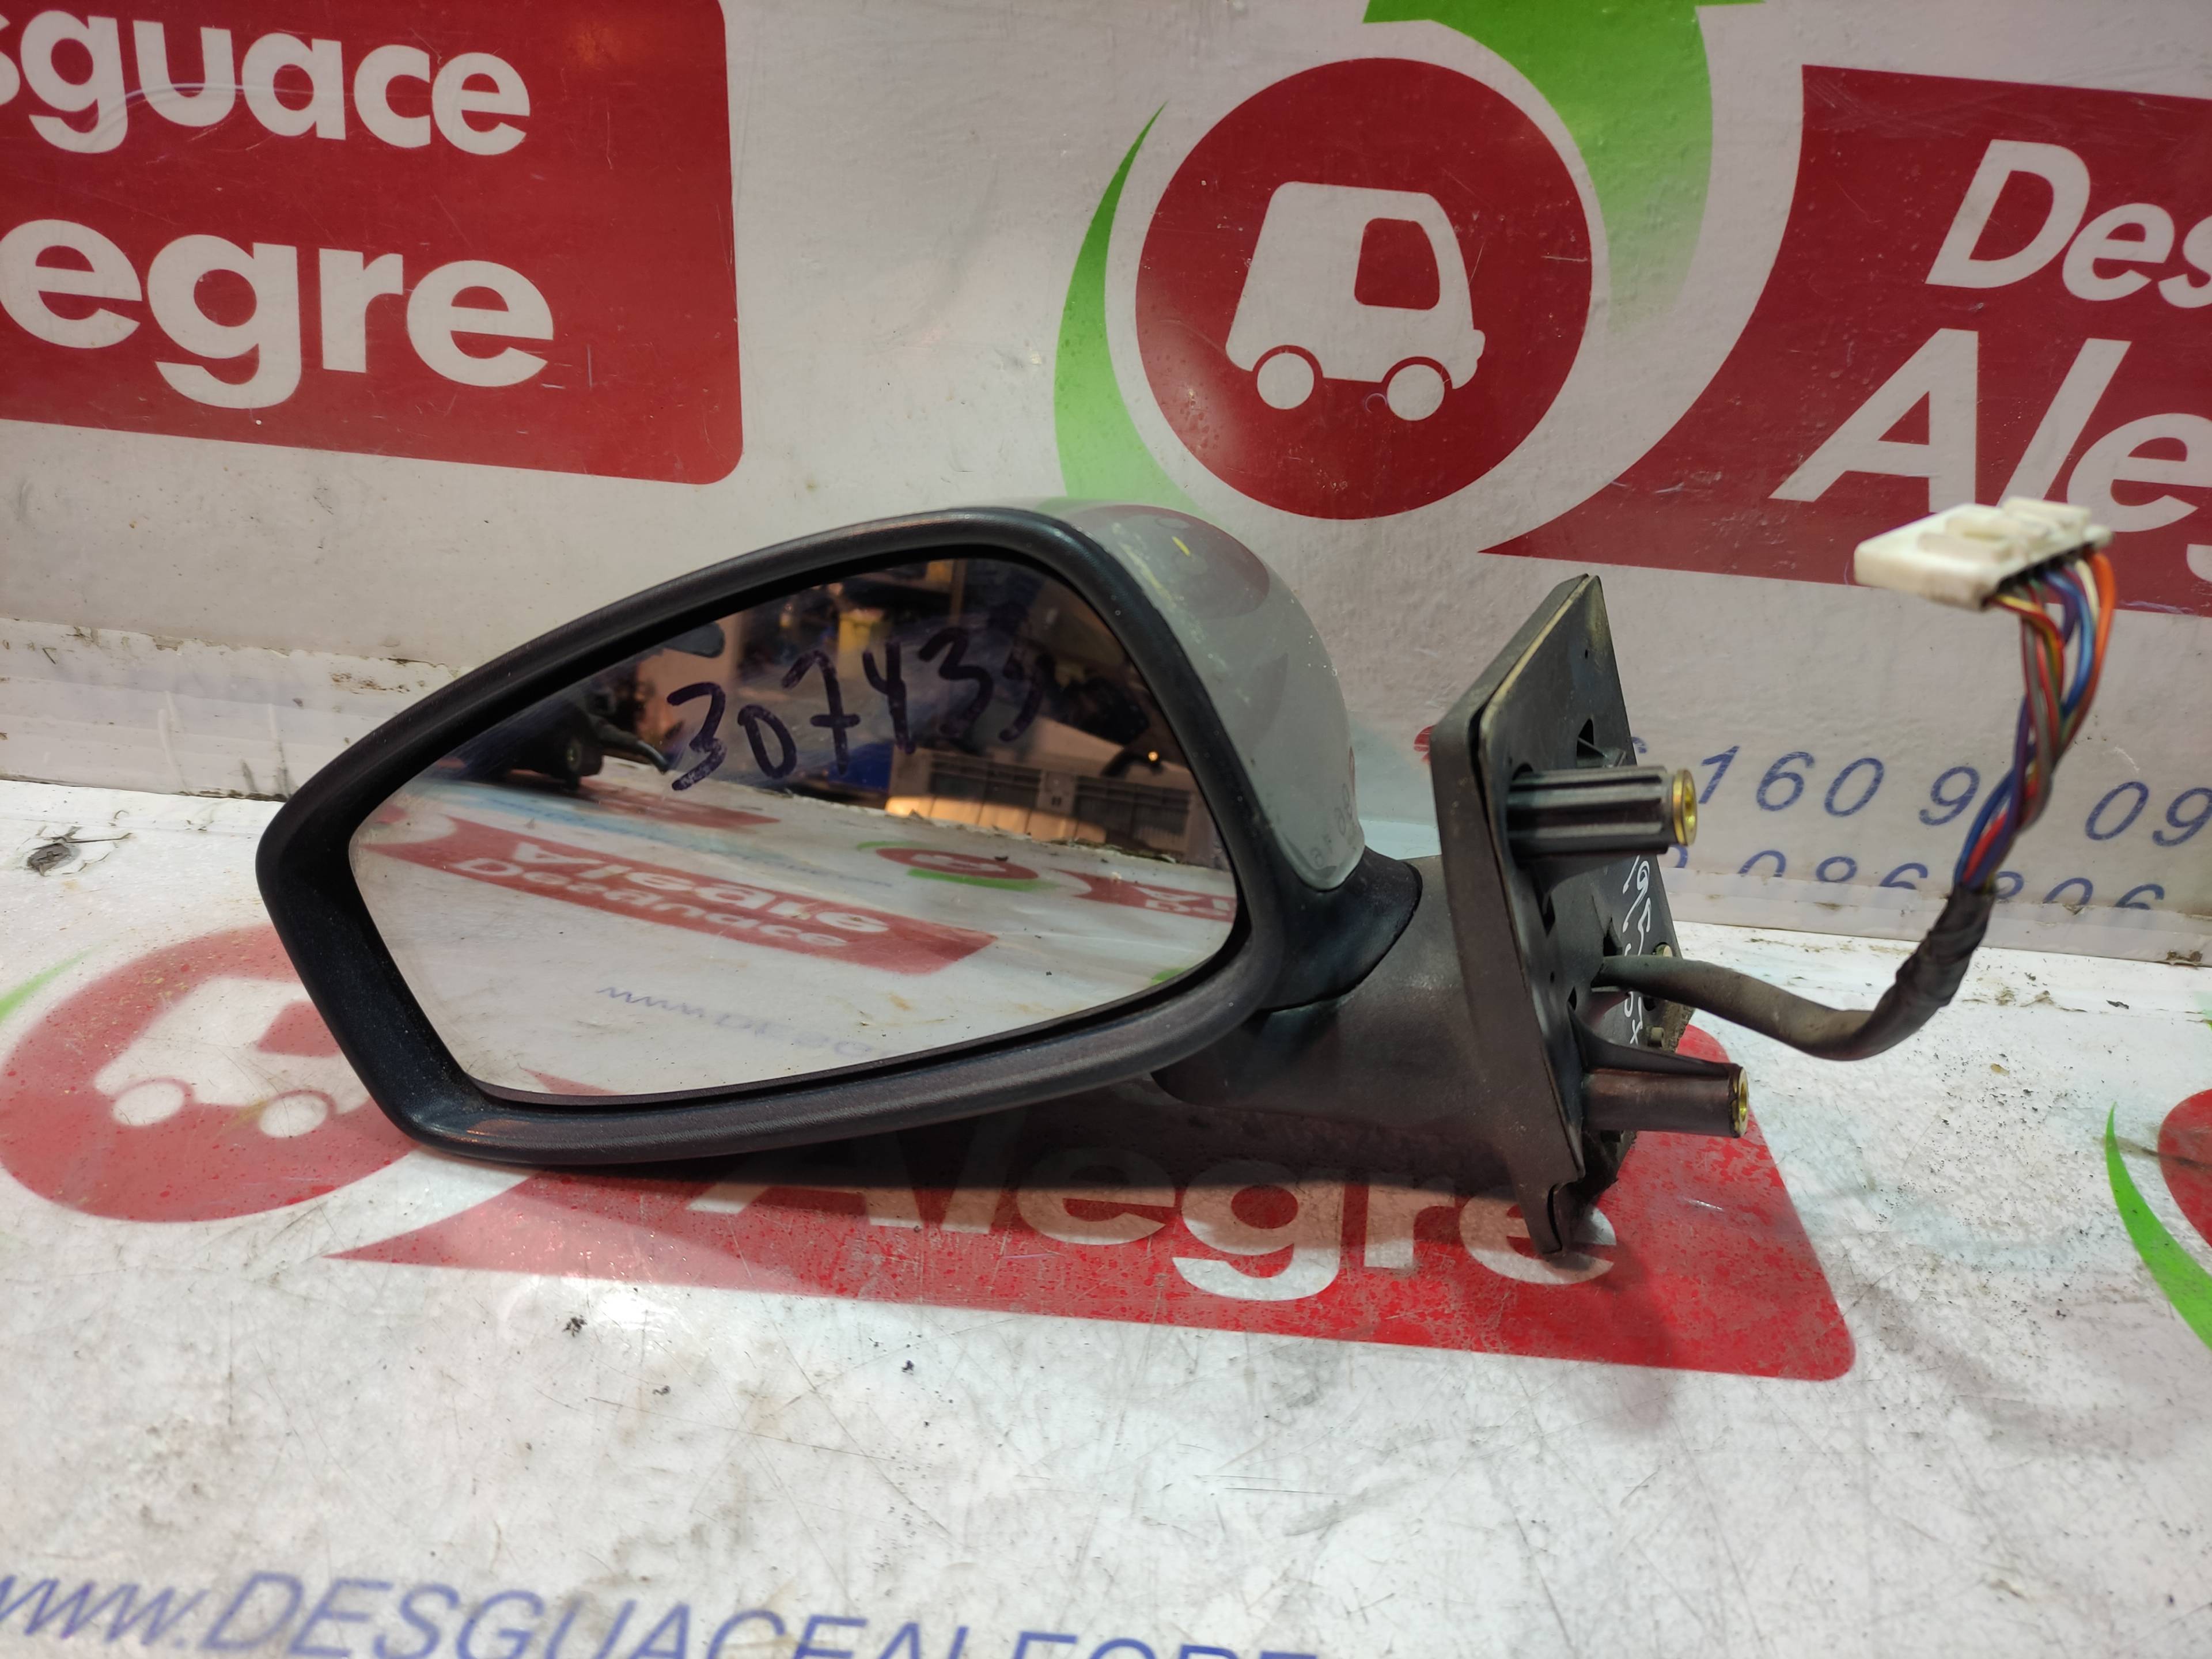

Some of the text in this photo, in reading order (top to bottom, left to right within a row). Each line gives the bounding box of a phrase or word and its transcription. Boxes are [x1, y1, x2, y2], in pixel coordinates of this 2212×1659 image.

[0, 7, 531, 156] guace
[0, 219, 554, 409] egre
[1768, 327, 2212, 583] Ale
[1698, 745, 1885, 817] 160
